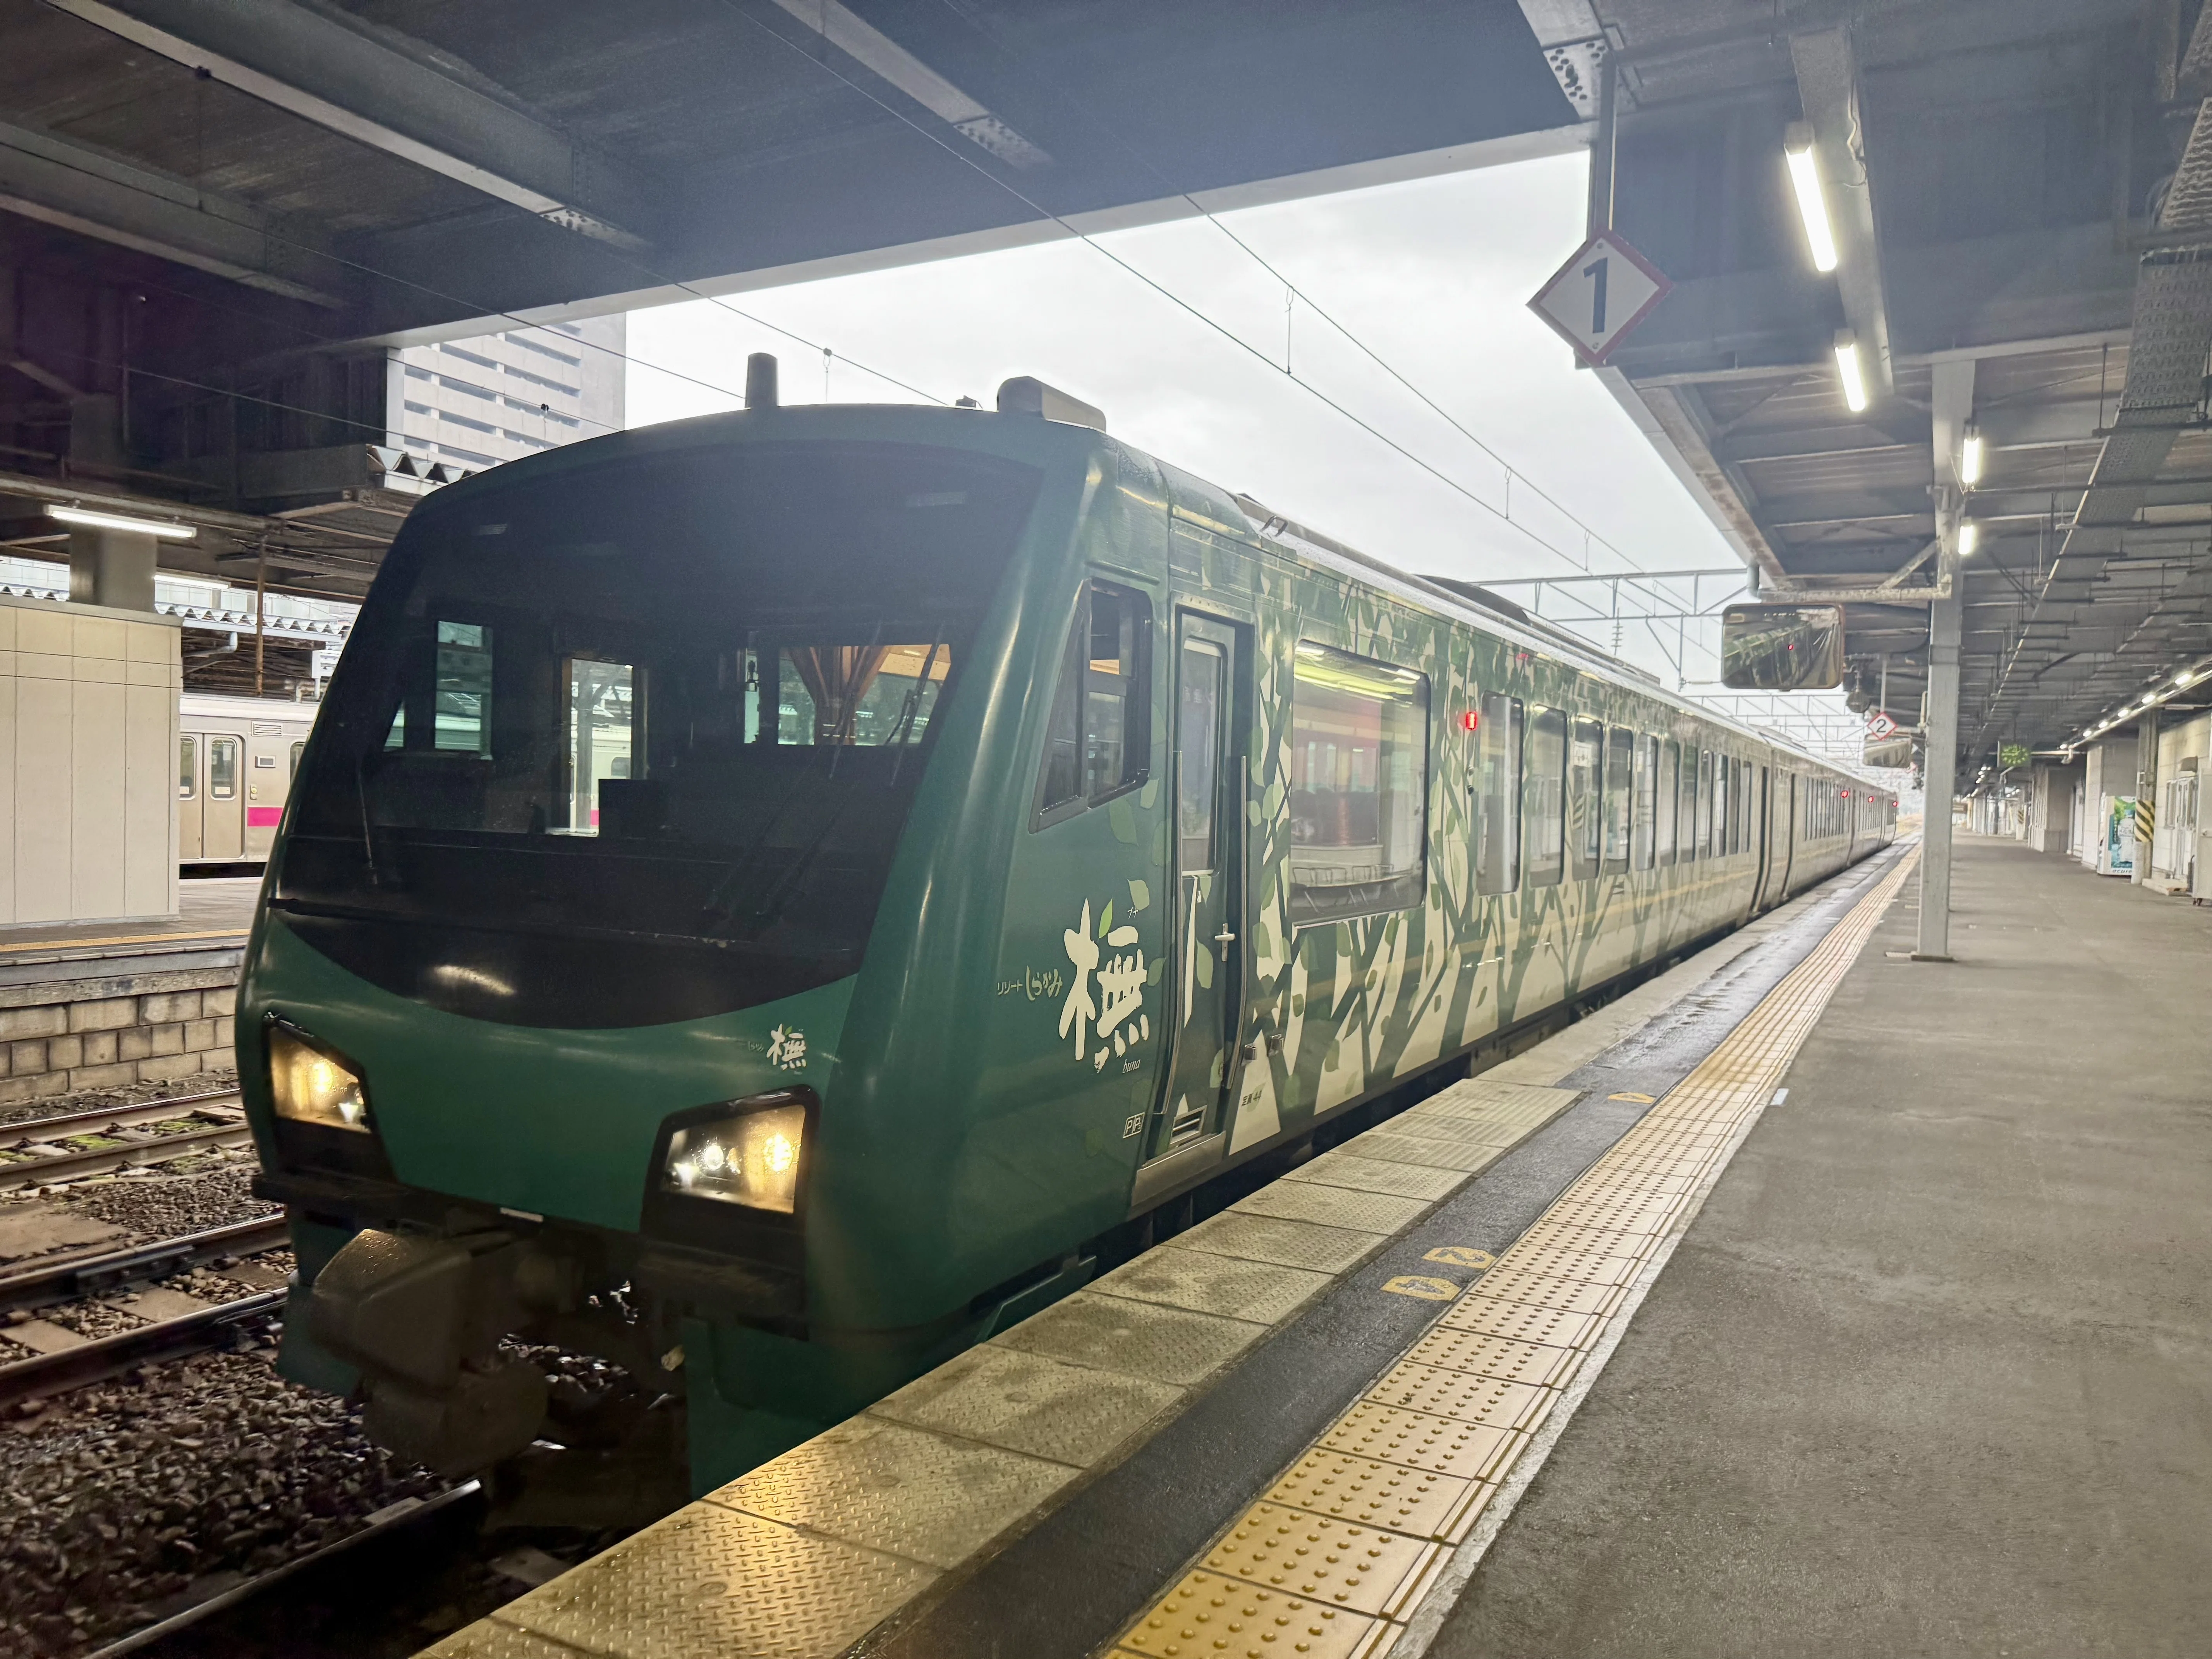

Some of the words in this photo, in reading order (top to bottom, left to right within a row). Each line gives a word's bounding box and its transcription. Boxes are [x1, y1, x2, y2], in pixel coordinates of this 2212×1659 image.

[1583, 257, 1608, 334] 1
[1876, 719, 1887, 733] 2
[1026, 965, 1063, 1001] しらかみ
[1122, 1059, 1141, 1073] buna
